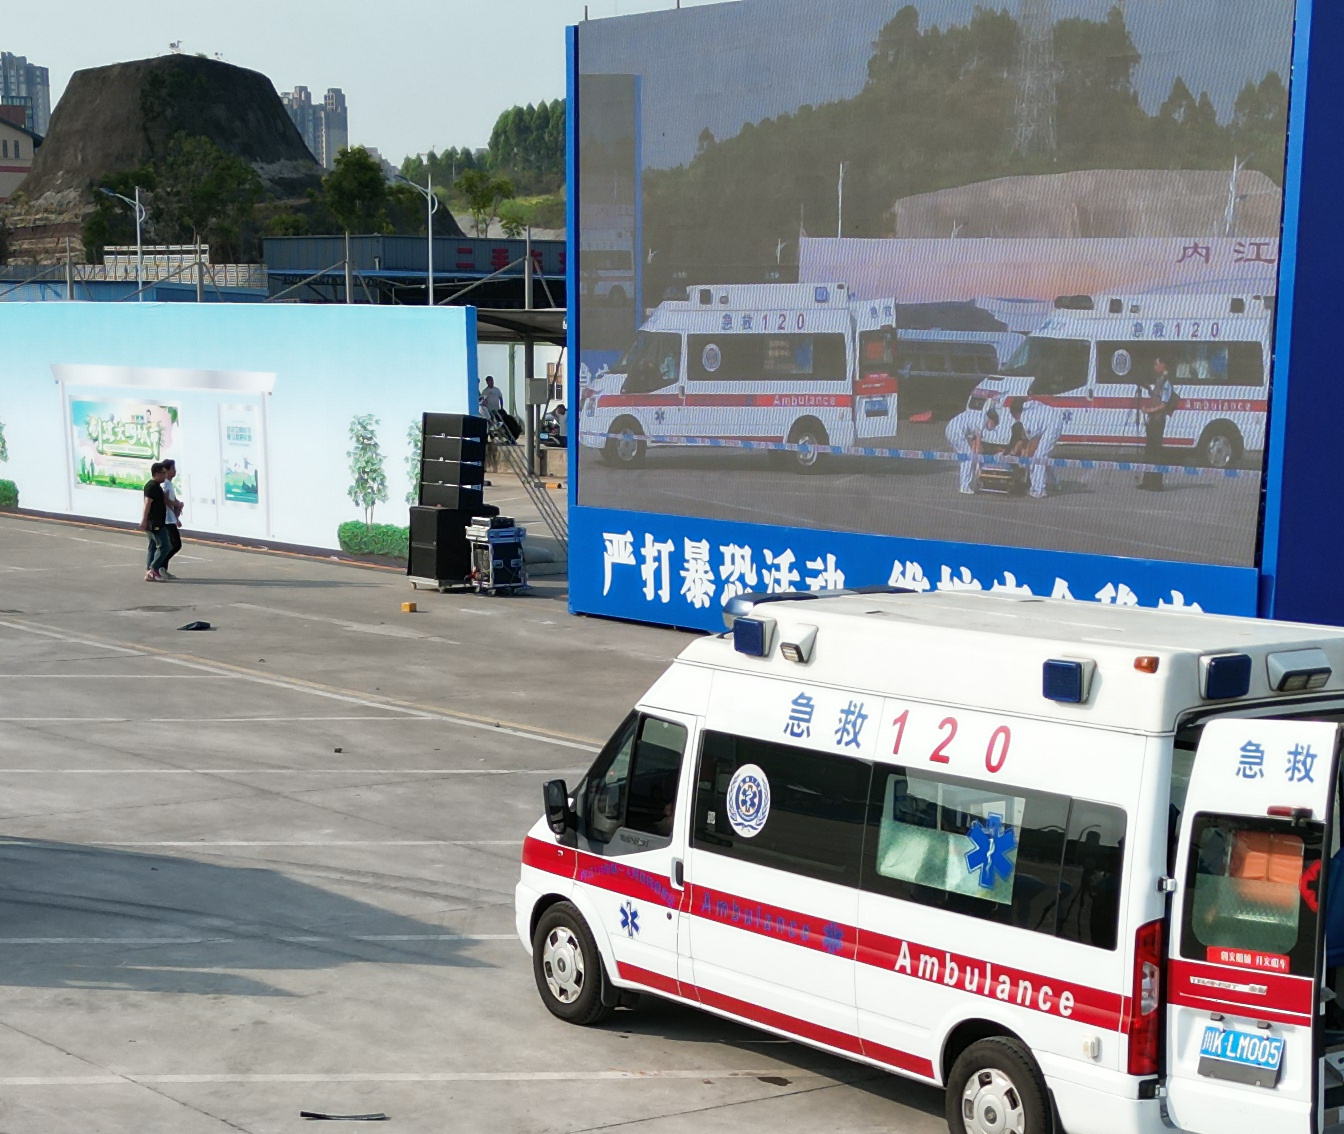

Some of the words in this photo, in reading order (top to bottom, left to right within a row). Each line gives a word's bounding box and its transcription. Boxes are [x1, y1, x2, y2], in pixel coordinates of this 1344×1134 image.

[1176, 241, 1276, 264] 内江
[773, 394, 836, 406] Ambulance
[602, 530, 846, 609] 严打暴恐活动
[1235, 739, 1318, 784] 急救
[700, 891, 811, 942] Ambulance
[894, 940, 1075, 1017] Ambulance
